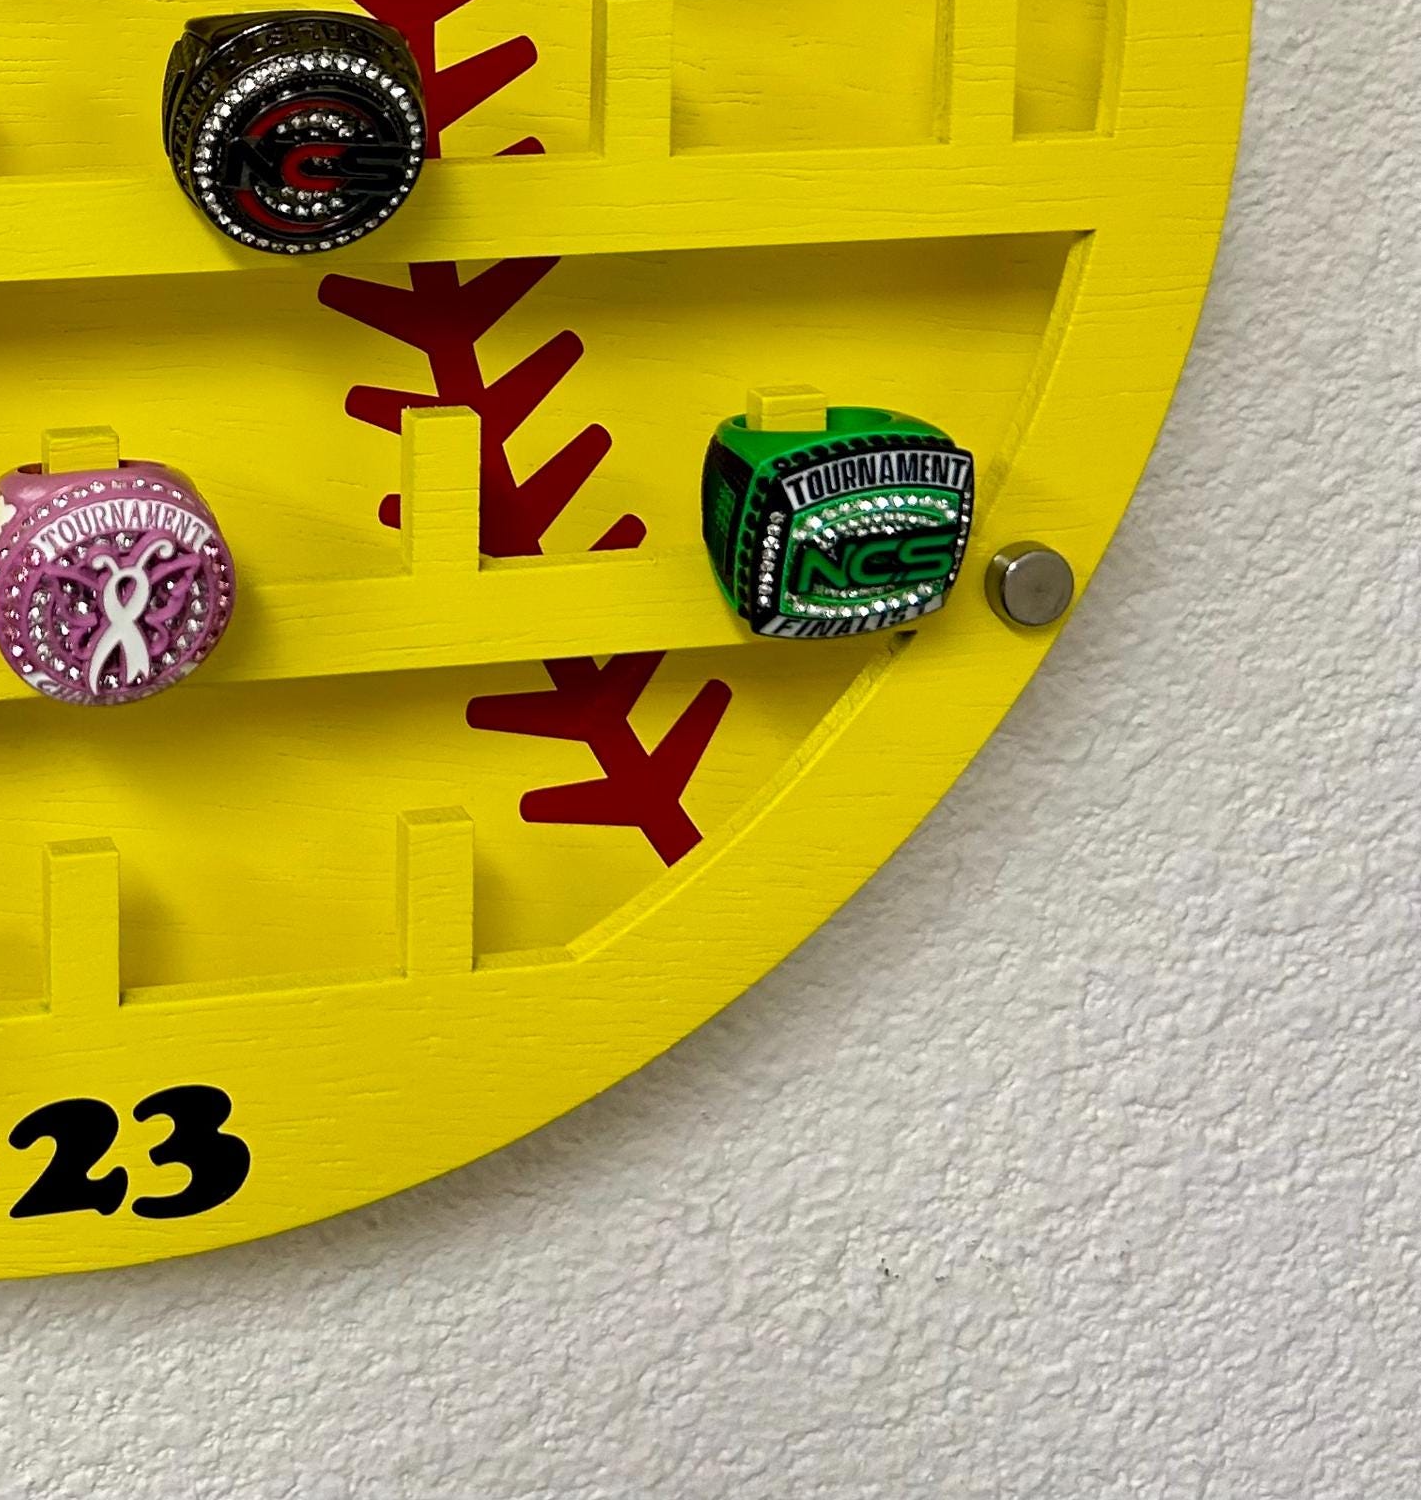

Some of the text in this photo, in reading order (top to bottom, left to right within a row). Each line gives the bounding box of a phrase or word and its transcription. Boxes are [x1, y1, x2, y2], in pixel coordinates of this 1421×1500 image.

[785, 451, 968, 506] TOURNAMENT
[39, 498, 206, 553] TOURNAMENT
[797, 533, 958, 593] NCS
